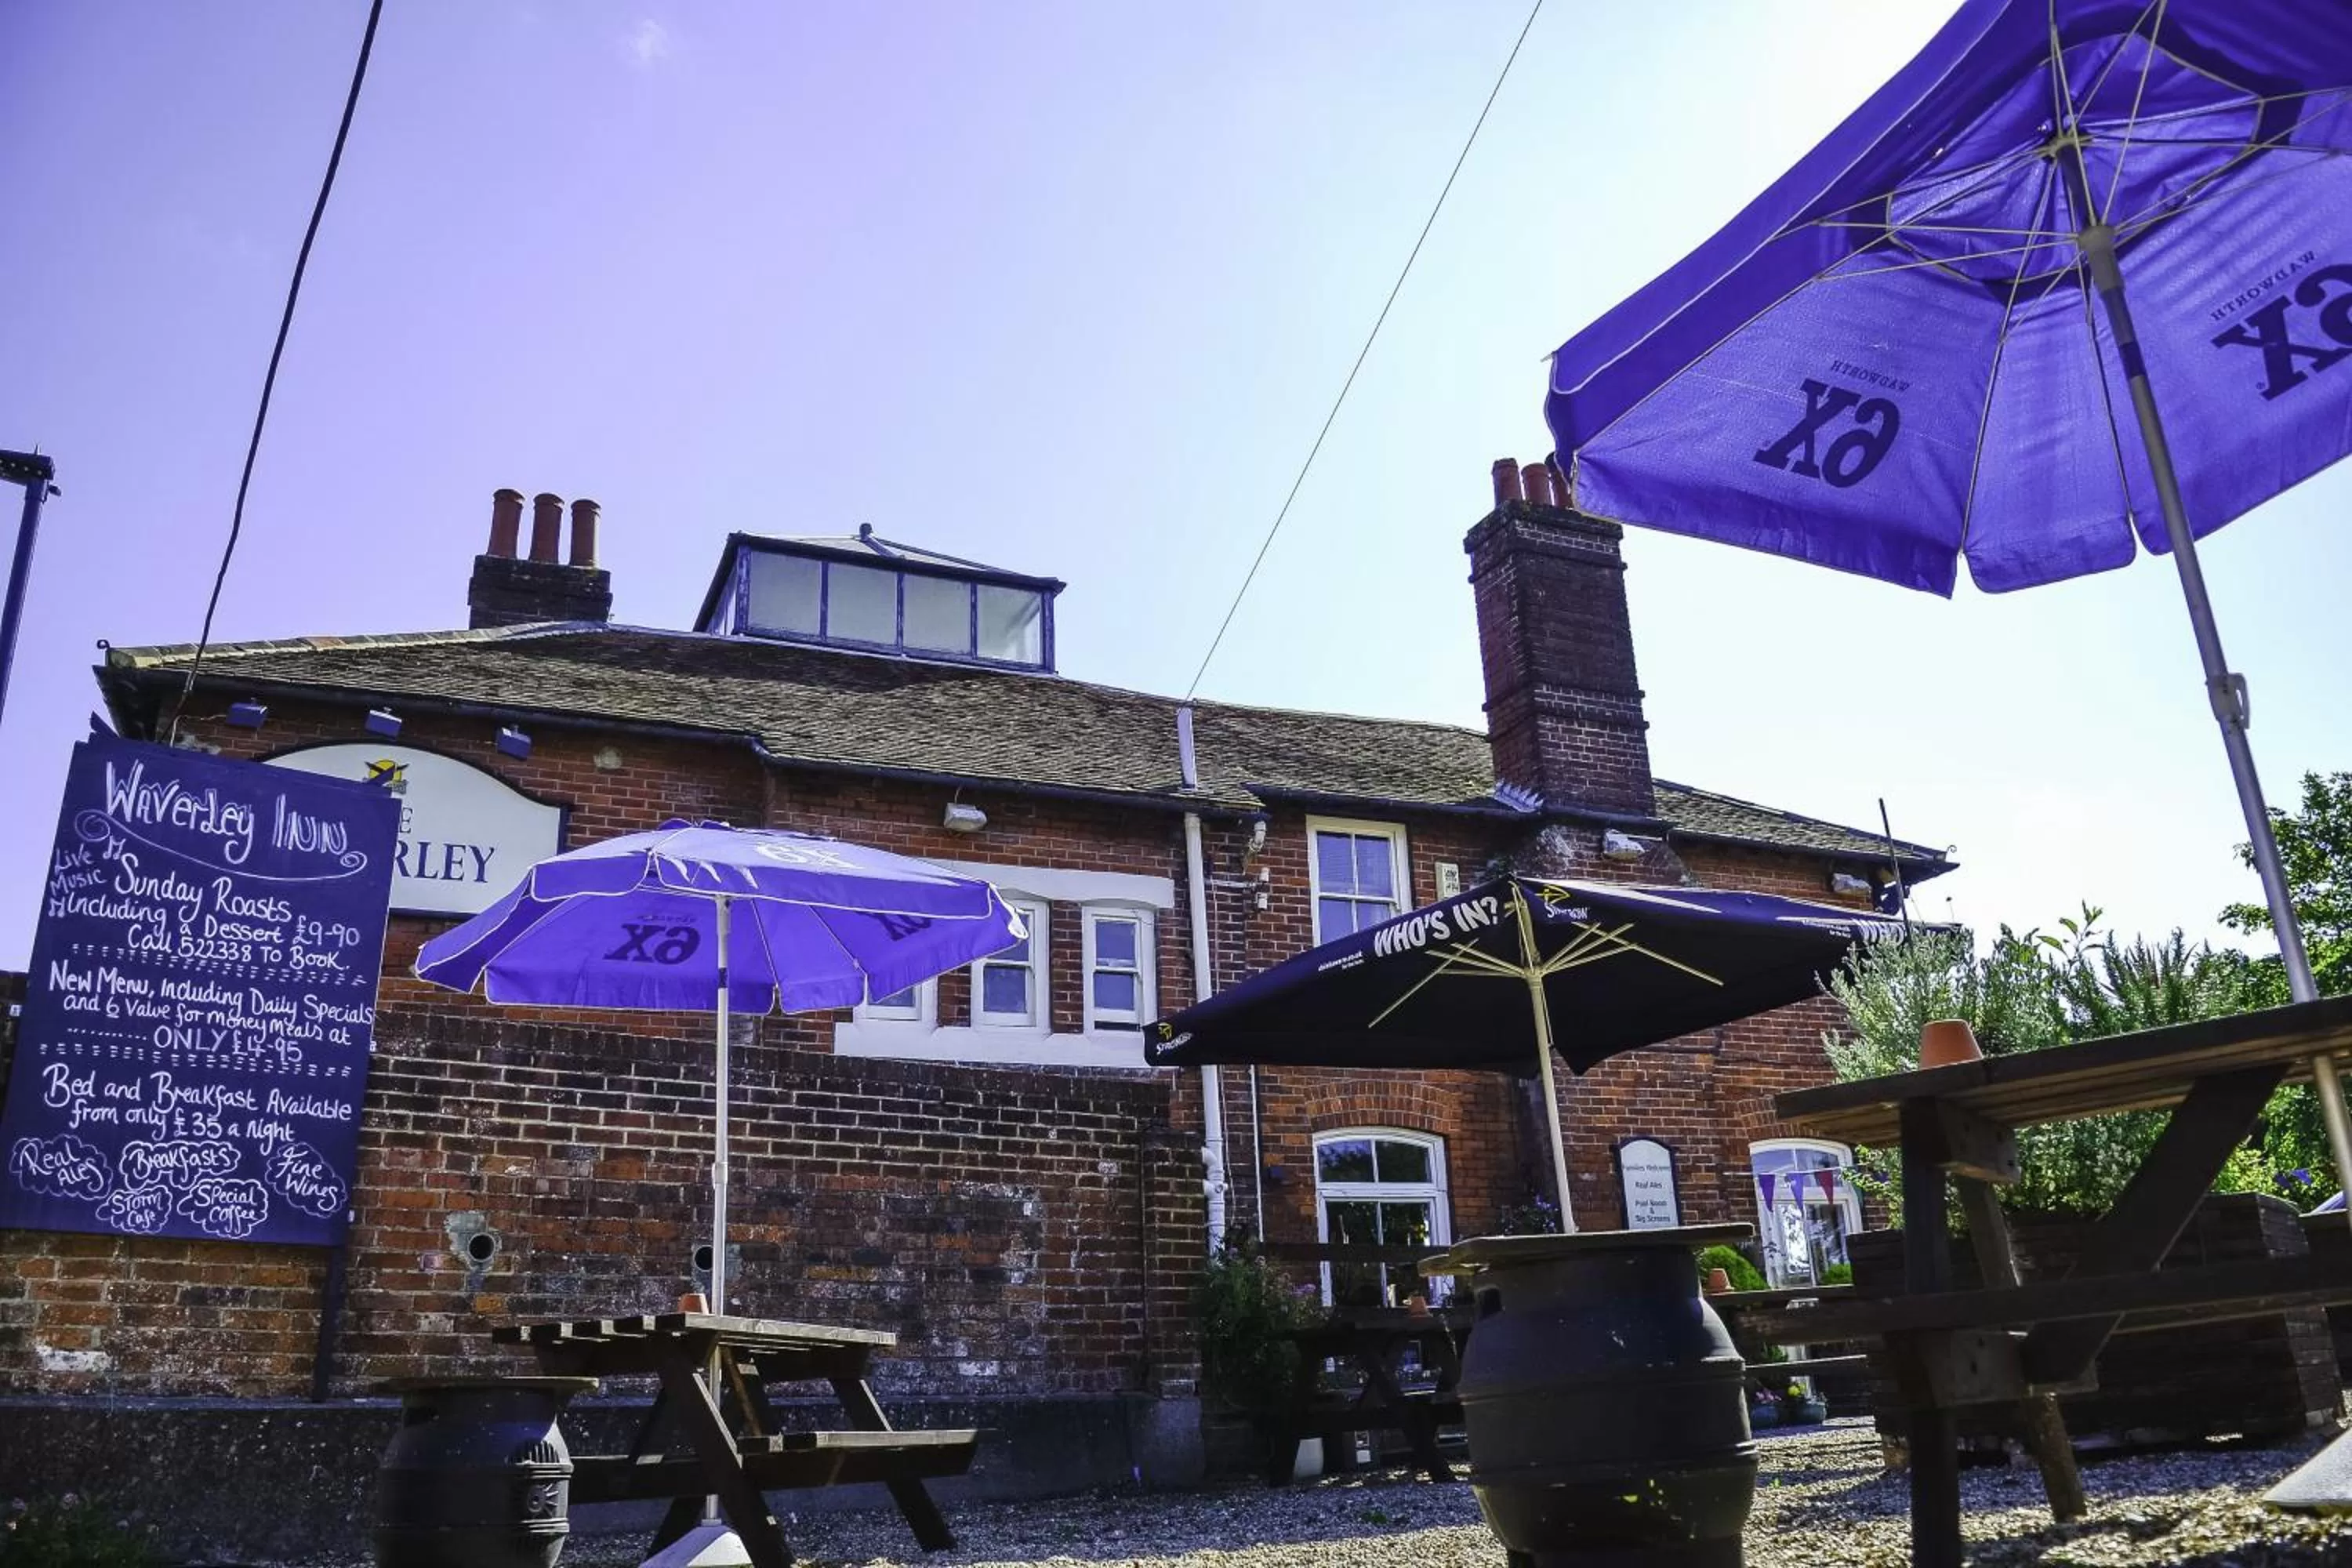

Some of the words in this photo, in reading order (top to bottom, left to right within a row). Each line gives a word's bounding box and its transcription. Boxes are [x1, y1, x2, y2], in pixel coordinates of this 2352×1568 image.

[54, 843, 94, 875] Live
[394, 840, 495, 883] RLEY
[50, 869, 107, 896] Music
[114, 853, 202, 923] Sunday
[212, 877, 292, 922] Roasts
[67, 891, 166, 937] Including
[180, 924, 191, 935] a
[204, 914, 285, 943] Dessert
[1374, 910, 1450, 957] WHO'S
[1453, 896, 1497, 932] IN?
[128, 924, 172, 954] Call
[178, 937, 252, 962] 522338
[49, 960, 92, 993] New
[161, 978, 242, 1018] Including
[249, 988, 297, 1025] Daily
[303, 994, 373, 1025] Specials
[64, 993, 100, 1012] and
[106, 996, 119, 1017] 6
[125, 998, 171, 1020] Value
[175, 1003, 205, 1028] for
[207, 1009, 266, 1044] money
[329, 1026, 351, 1045] at
[154, 1025, 228, 1051] ONLY
[42, 1063, 96, 1107] Bed
[104, 1077, 141, 1101] and
[150, 1071, 259, 1116] Breakfast
[266, 1088, 352, 1120] Available
[69, 1098, 118, 1128] from
[125, 1106, 166, 1142] only
[228, 1123, 240, 1137] a
[20, 1142, 81, 1175] Real
[57, 1158, 104, 1192] Ales
[129, 1146, 230, 1182] Breakfasts
[276, 1147, 323, 1179] Fine
[194, 1185, 257, 1207] Special
[285, 1174, 338, 1210] Wines
